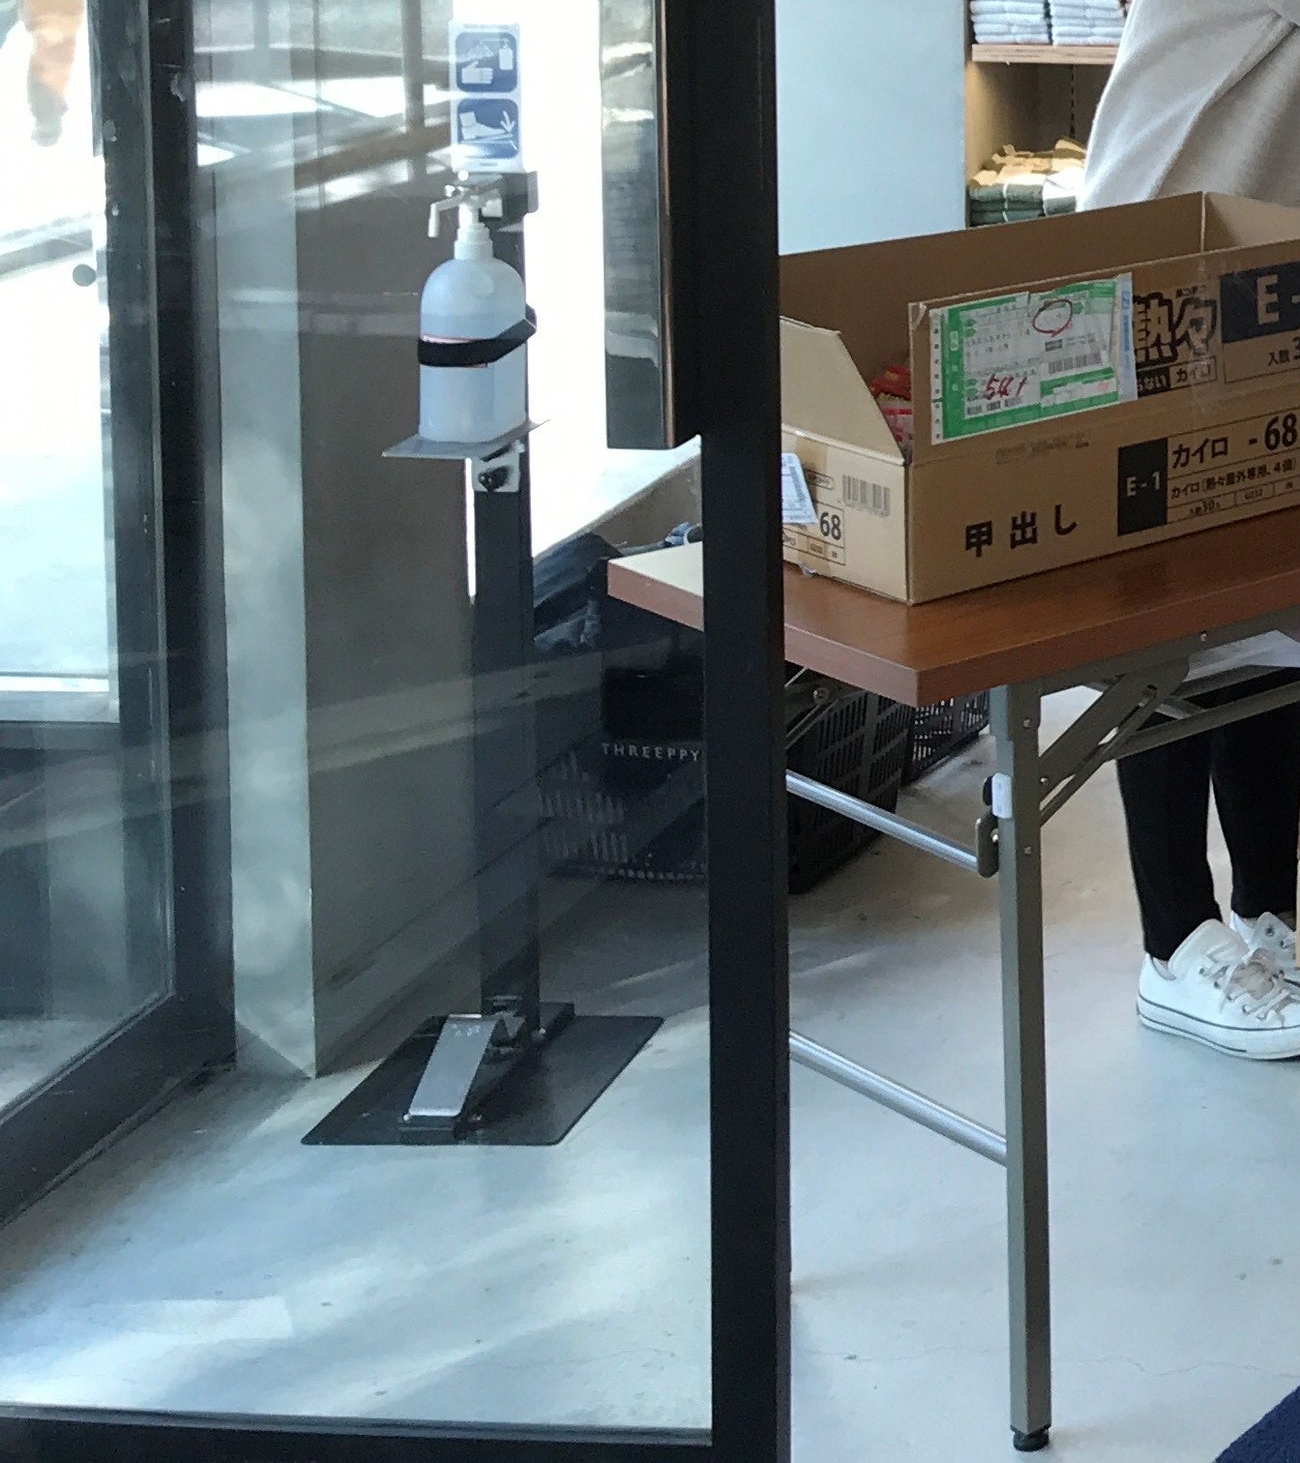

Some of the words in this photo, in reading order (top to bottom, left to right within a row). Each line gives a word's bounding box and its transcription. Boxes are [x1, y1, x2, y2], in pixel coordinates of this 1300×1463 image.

[1172, 437, 1229, 469] カイロ
[965, 504, 1079, 557] 甲出し
